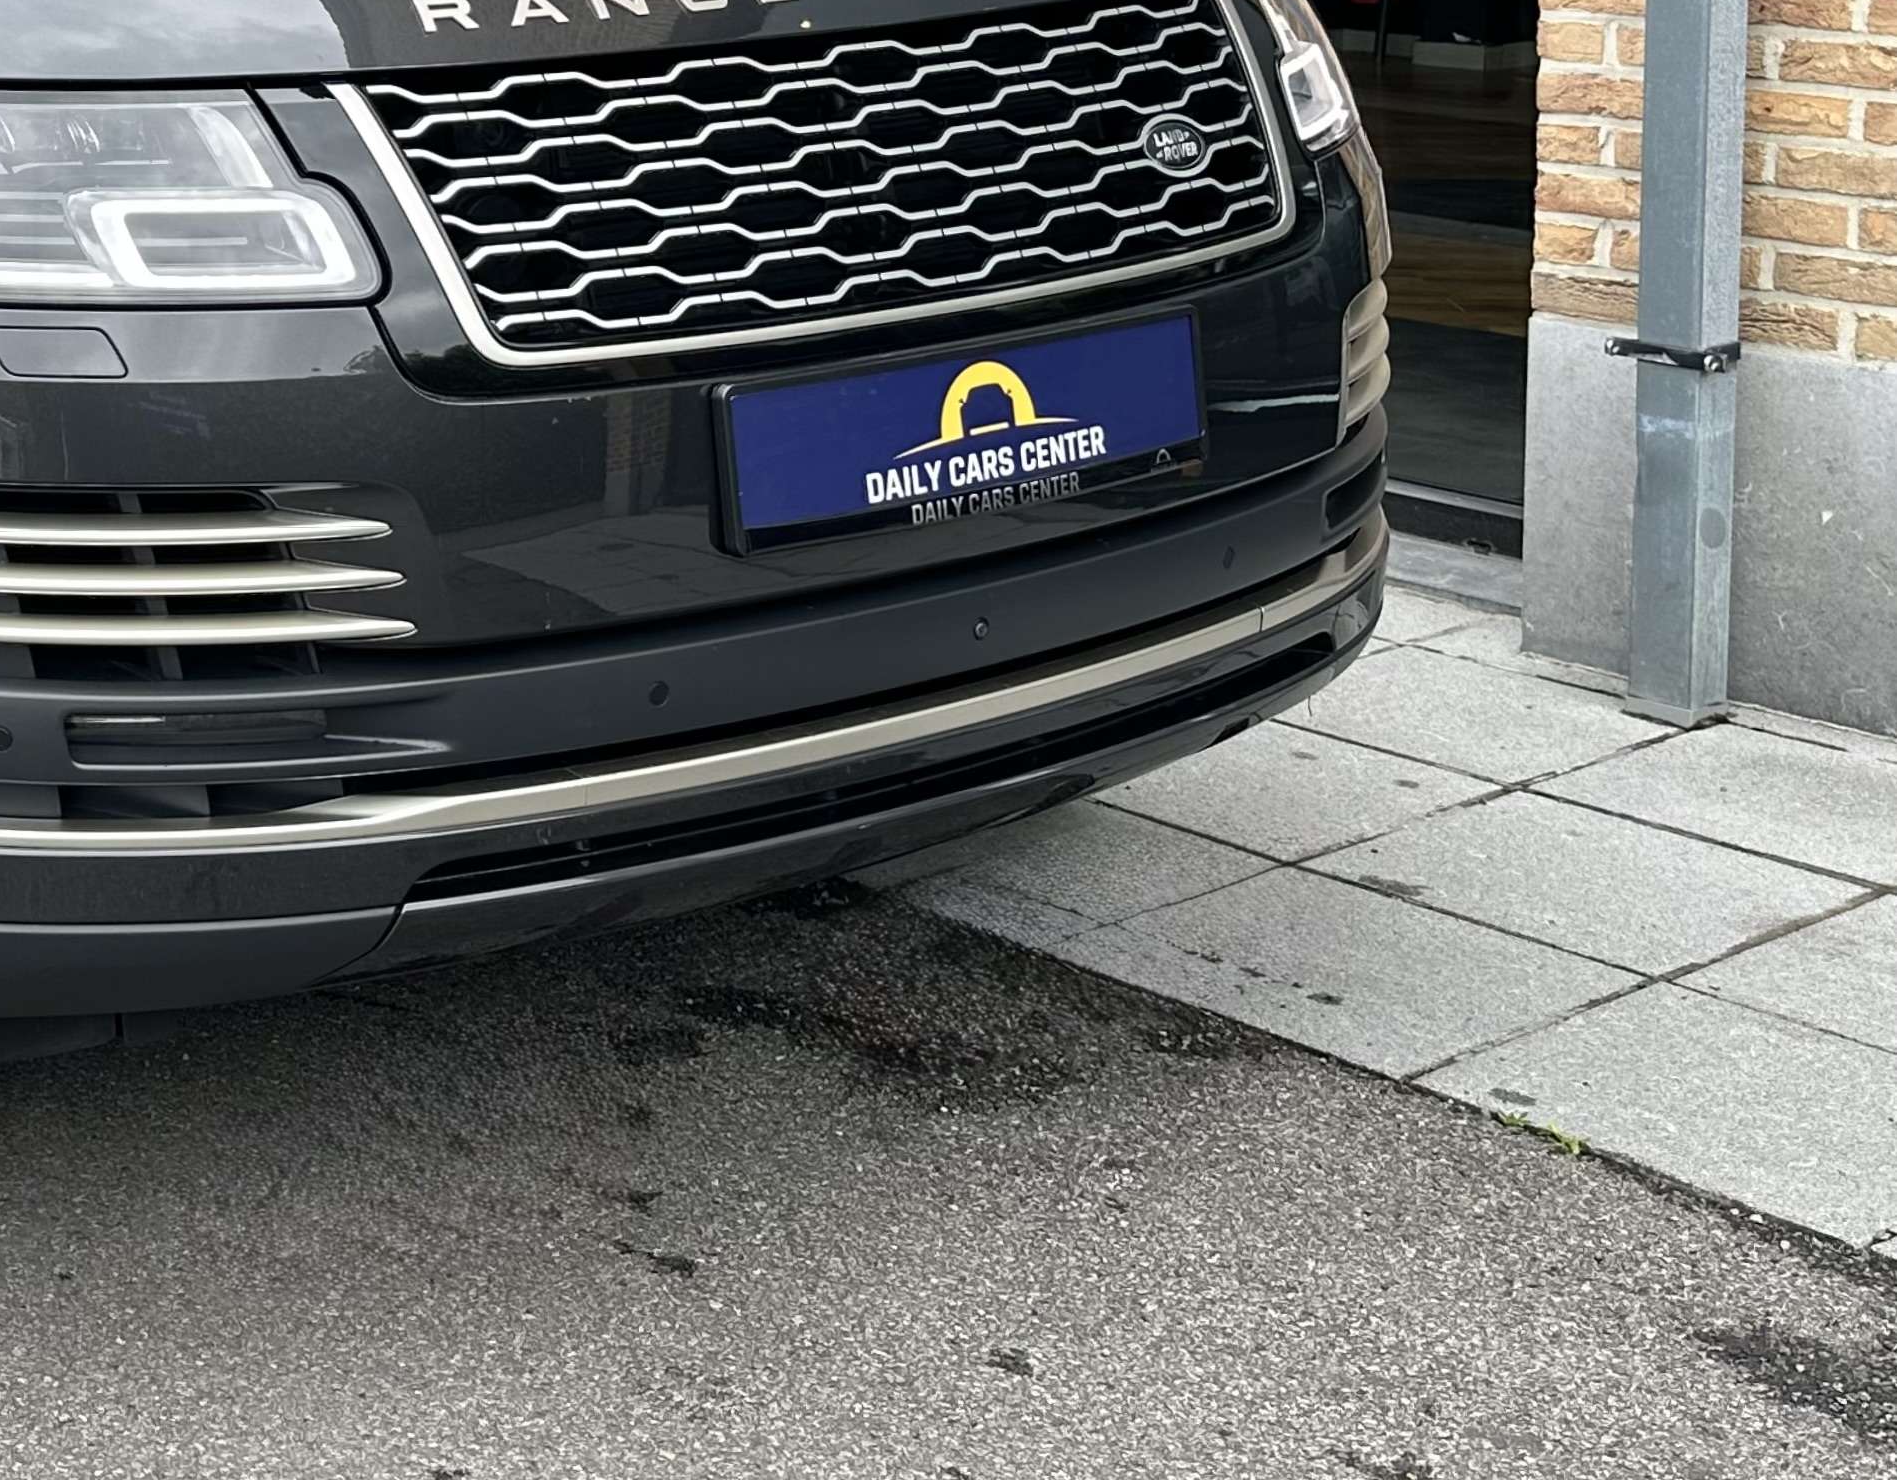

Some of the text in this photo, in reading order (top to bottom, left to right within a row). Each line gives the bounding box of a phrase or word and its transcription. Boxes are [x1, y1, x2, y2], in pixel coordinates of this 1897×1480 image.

[1152, 128, 1199, 161] LAND ROVER
[865, 425, 1107, 505] DAILY CARS CENTER
[910, 471, 1081, 526] DAILY CARS CENTER
